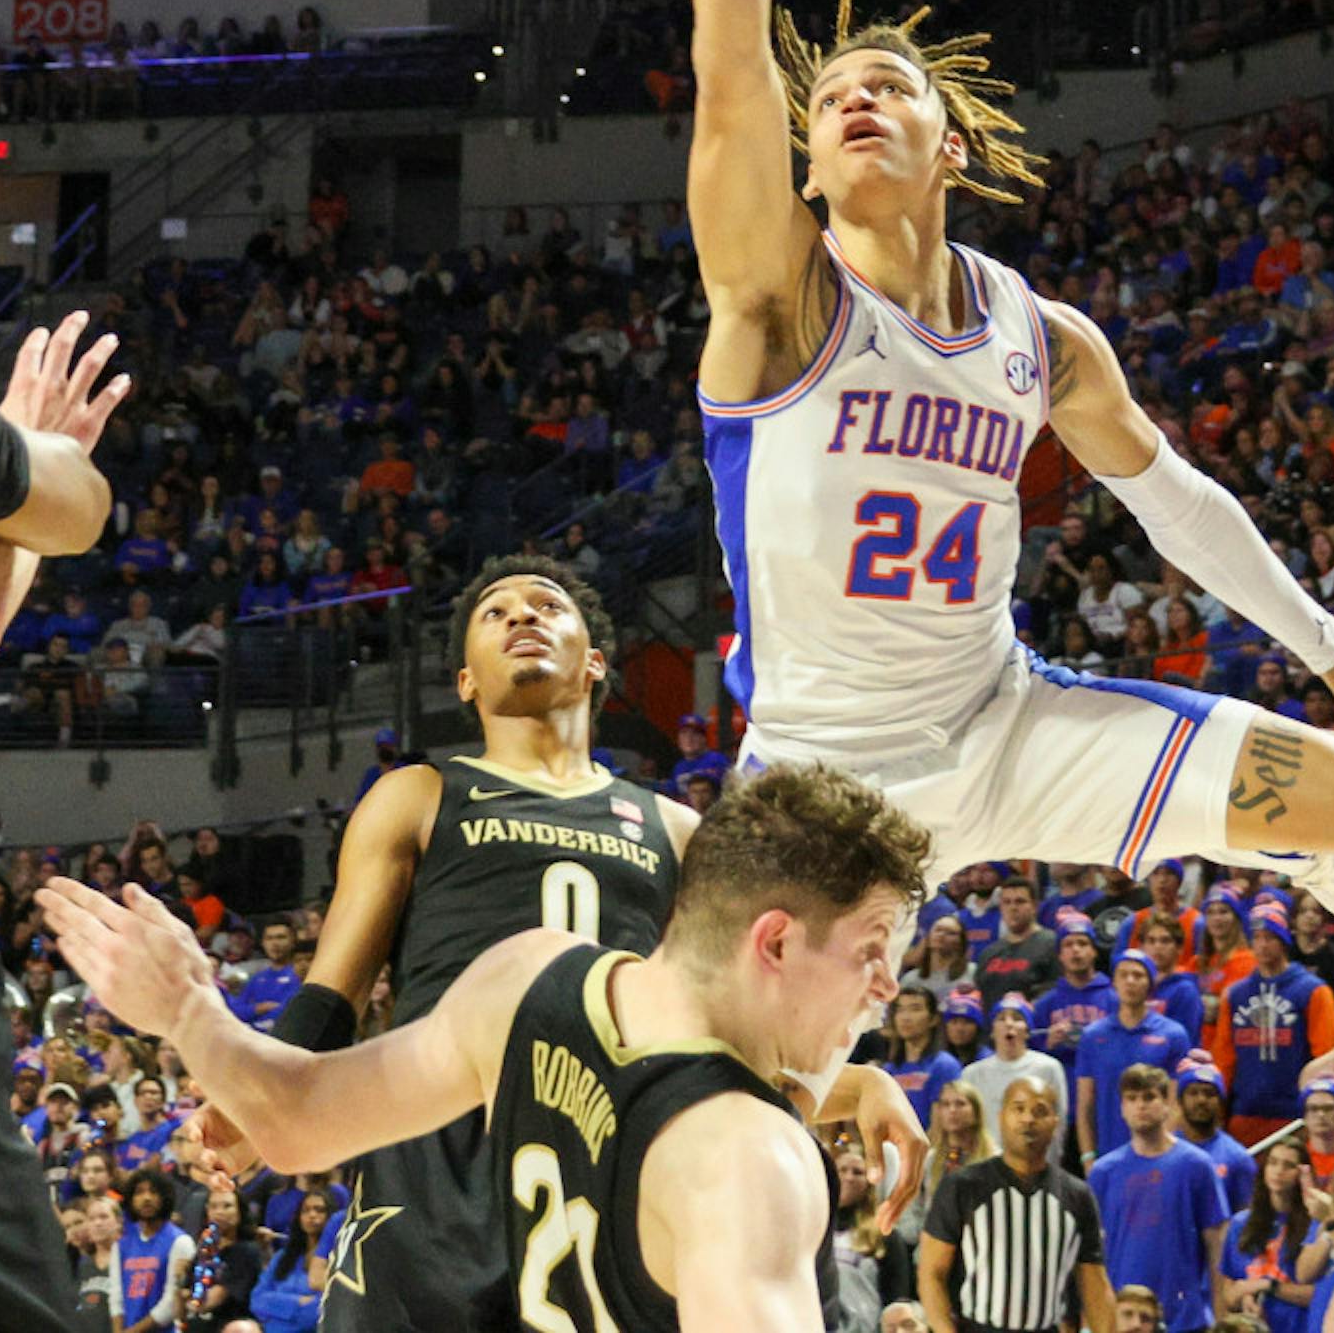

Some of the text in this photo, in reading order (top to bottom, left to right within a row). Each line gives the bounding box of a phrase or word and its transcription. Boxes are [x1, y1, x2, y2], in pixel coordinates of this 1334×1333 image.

[827, 389, 1024, 482] FLORIDA
[844, 490, 987, 605] 24
[460, 818, 660, 874] VANDERBILT
[541, 860, 601, 944] 0
